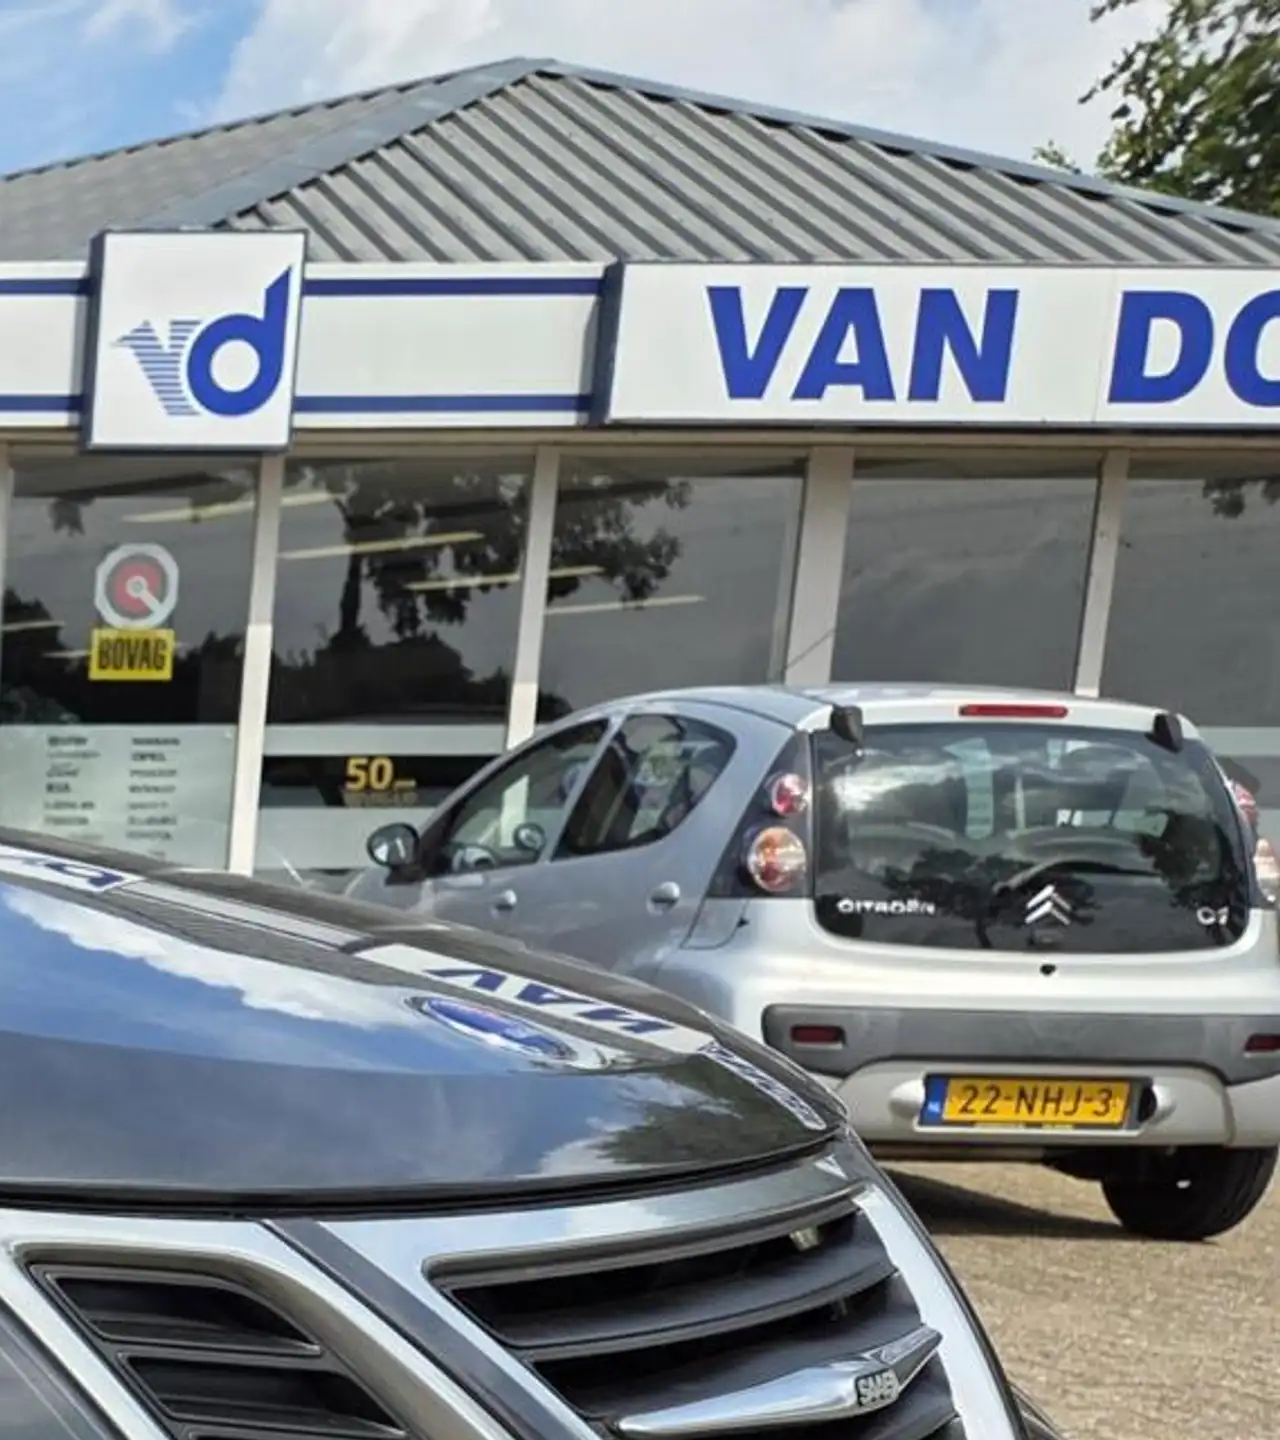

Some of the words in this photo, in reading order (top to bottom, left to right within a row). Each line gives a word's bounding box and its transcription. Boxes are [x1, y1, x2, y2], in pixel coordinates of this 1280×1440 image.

[706, 286, 1020, 403] VAN
[98, 637, 167, 671] BOVAG
[959, 1084, 1114, 1117] 22-NHJ-3
